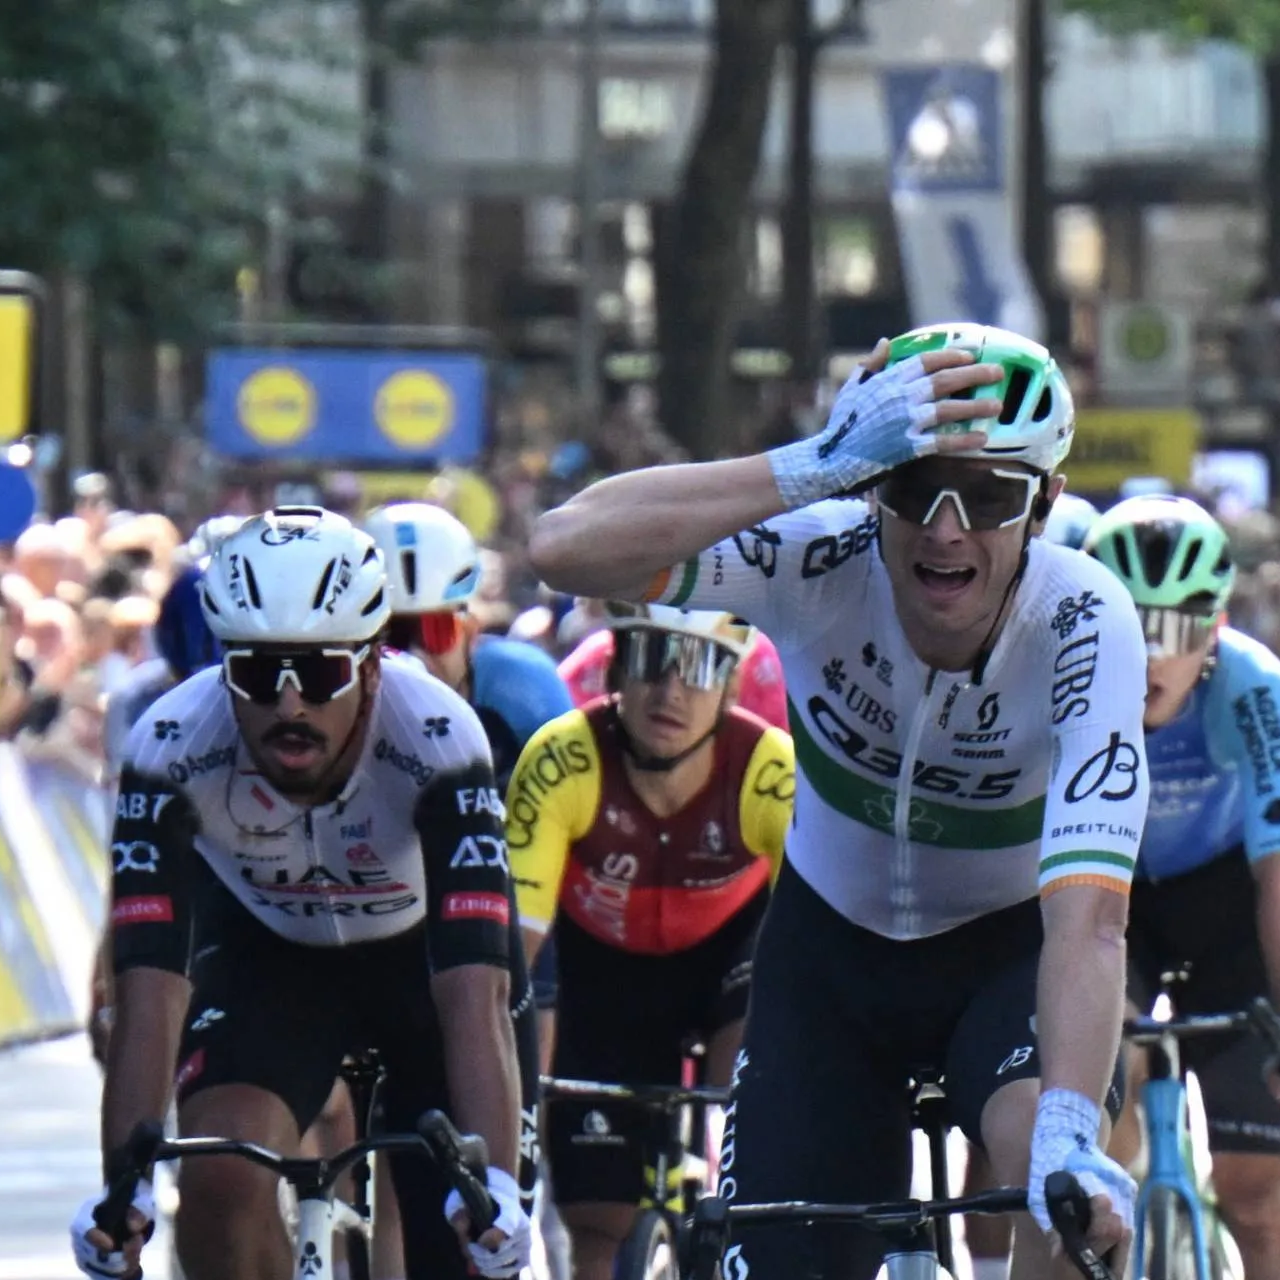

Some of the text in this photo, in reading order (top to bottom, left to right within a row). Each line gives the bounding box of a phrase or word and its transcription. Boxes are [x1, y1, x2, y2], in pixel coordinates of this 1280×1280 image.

[1051, 630, 1100, 726] UBS
[846, 683, 898, 734] UBS
[953, 728, 1013, 744] SCOTT
[1051, 822, 1139, 844] BREITLING
